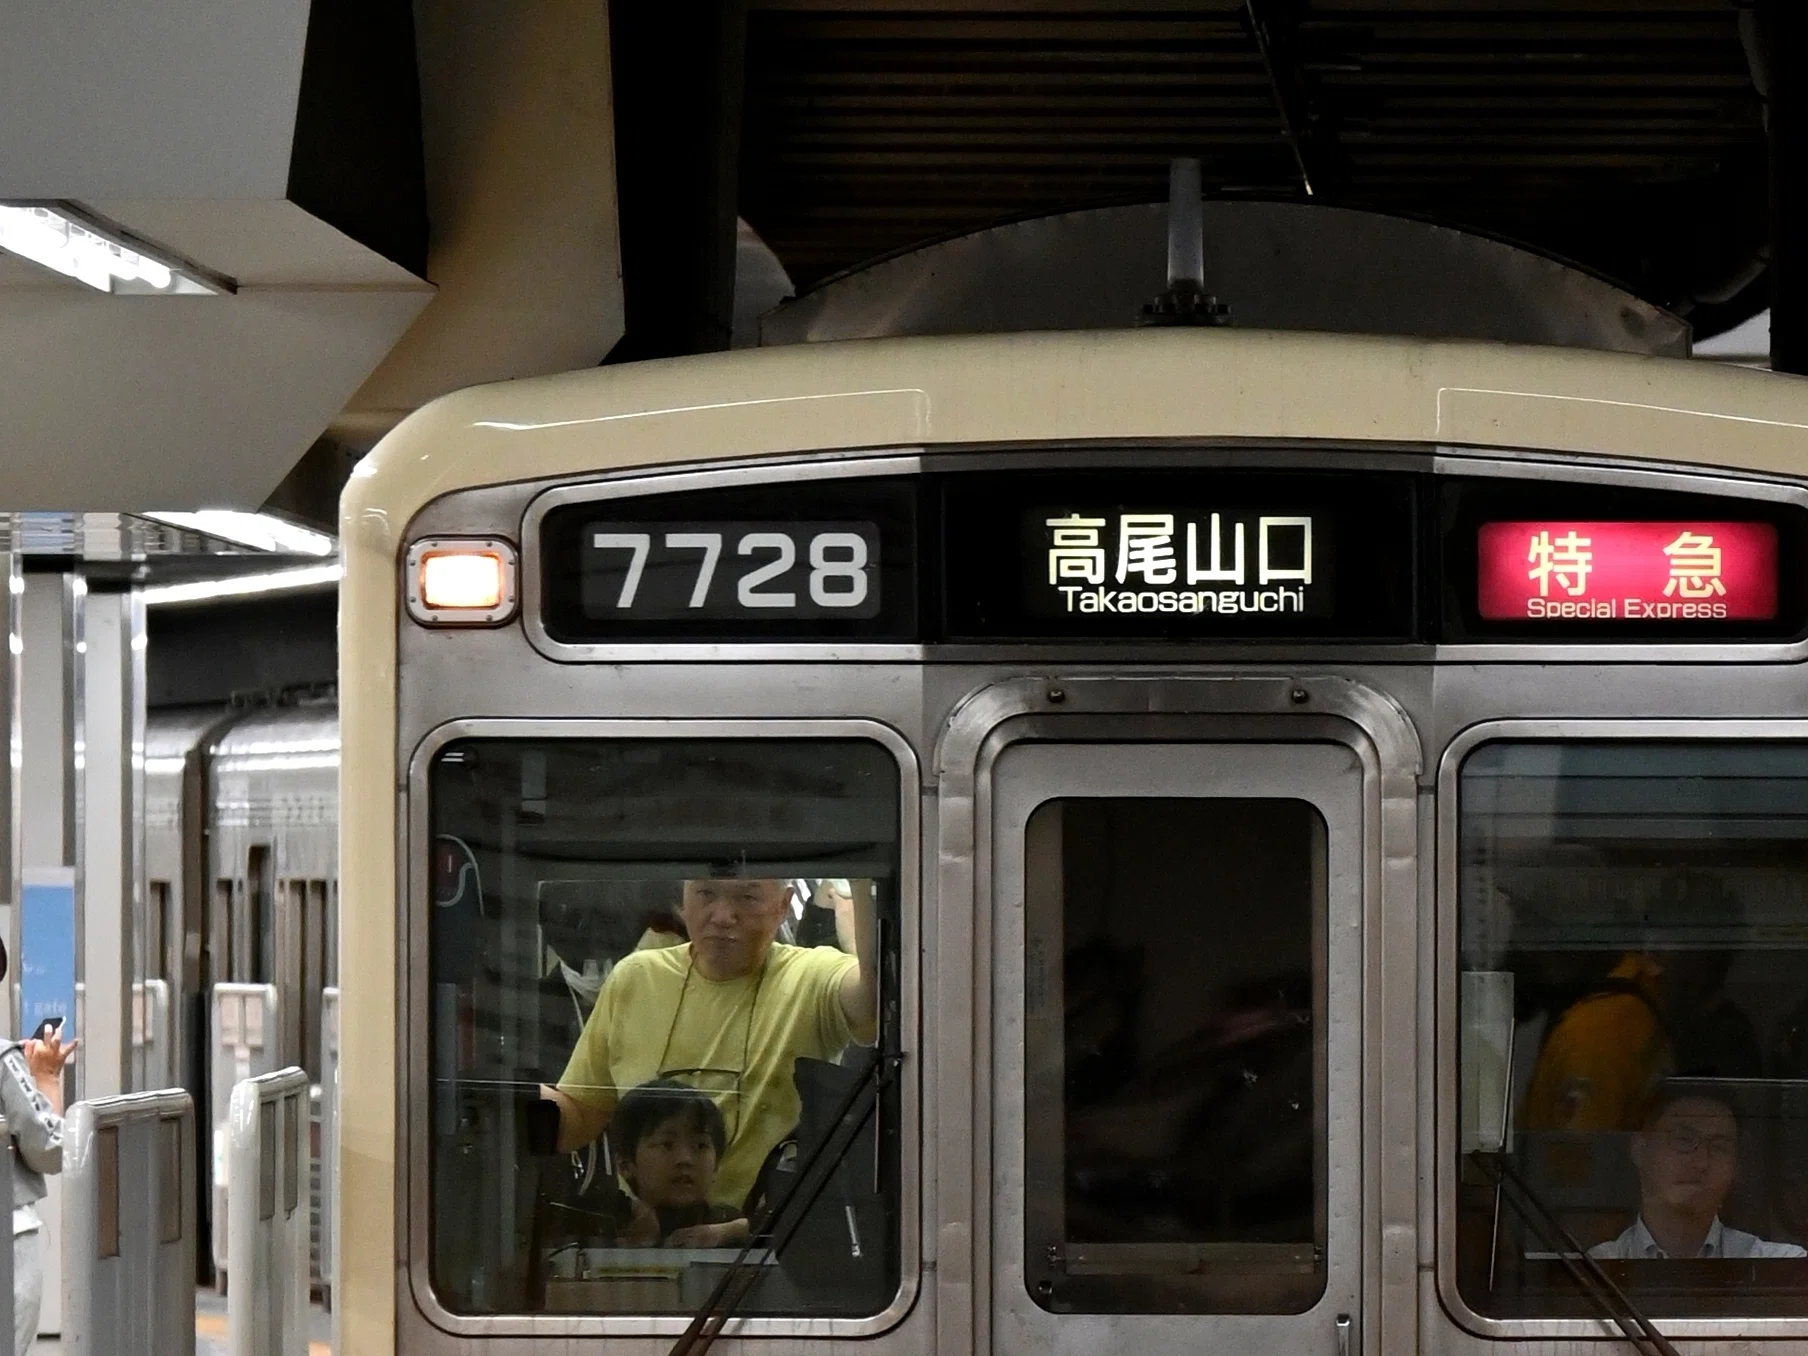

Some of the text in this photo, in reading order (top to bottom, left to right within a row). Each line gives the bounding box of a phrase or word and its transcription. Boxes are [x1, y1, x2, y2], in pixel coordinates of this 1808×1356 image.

[594, 533, 868, 608] 7728
[1046, 513, 1312, 585] 高尾山口
[1527, 531, 1727, 598] 特急
[1058, 586, 1304, 614] Takaosanguchi
[1527, 598, 1727, 619] Special Express
